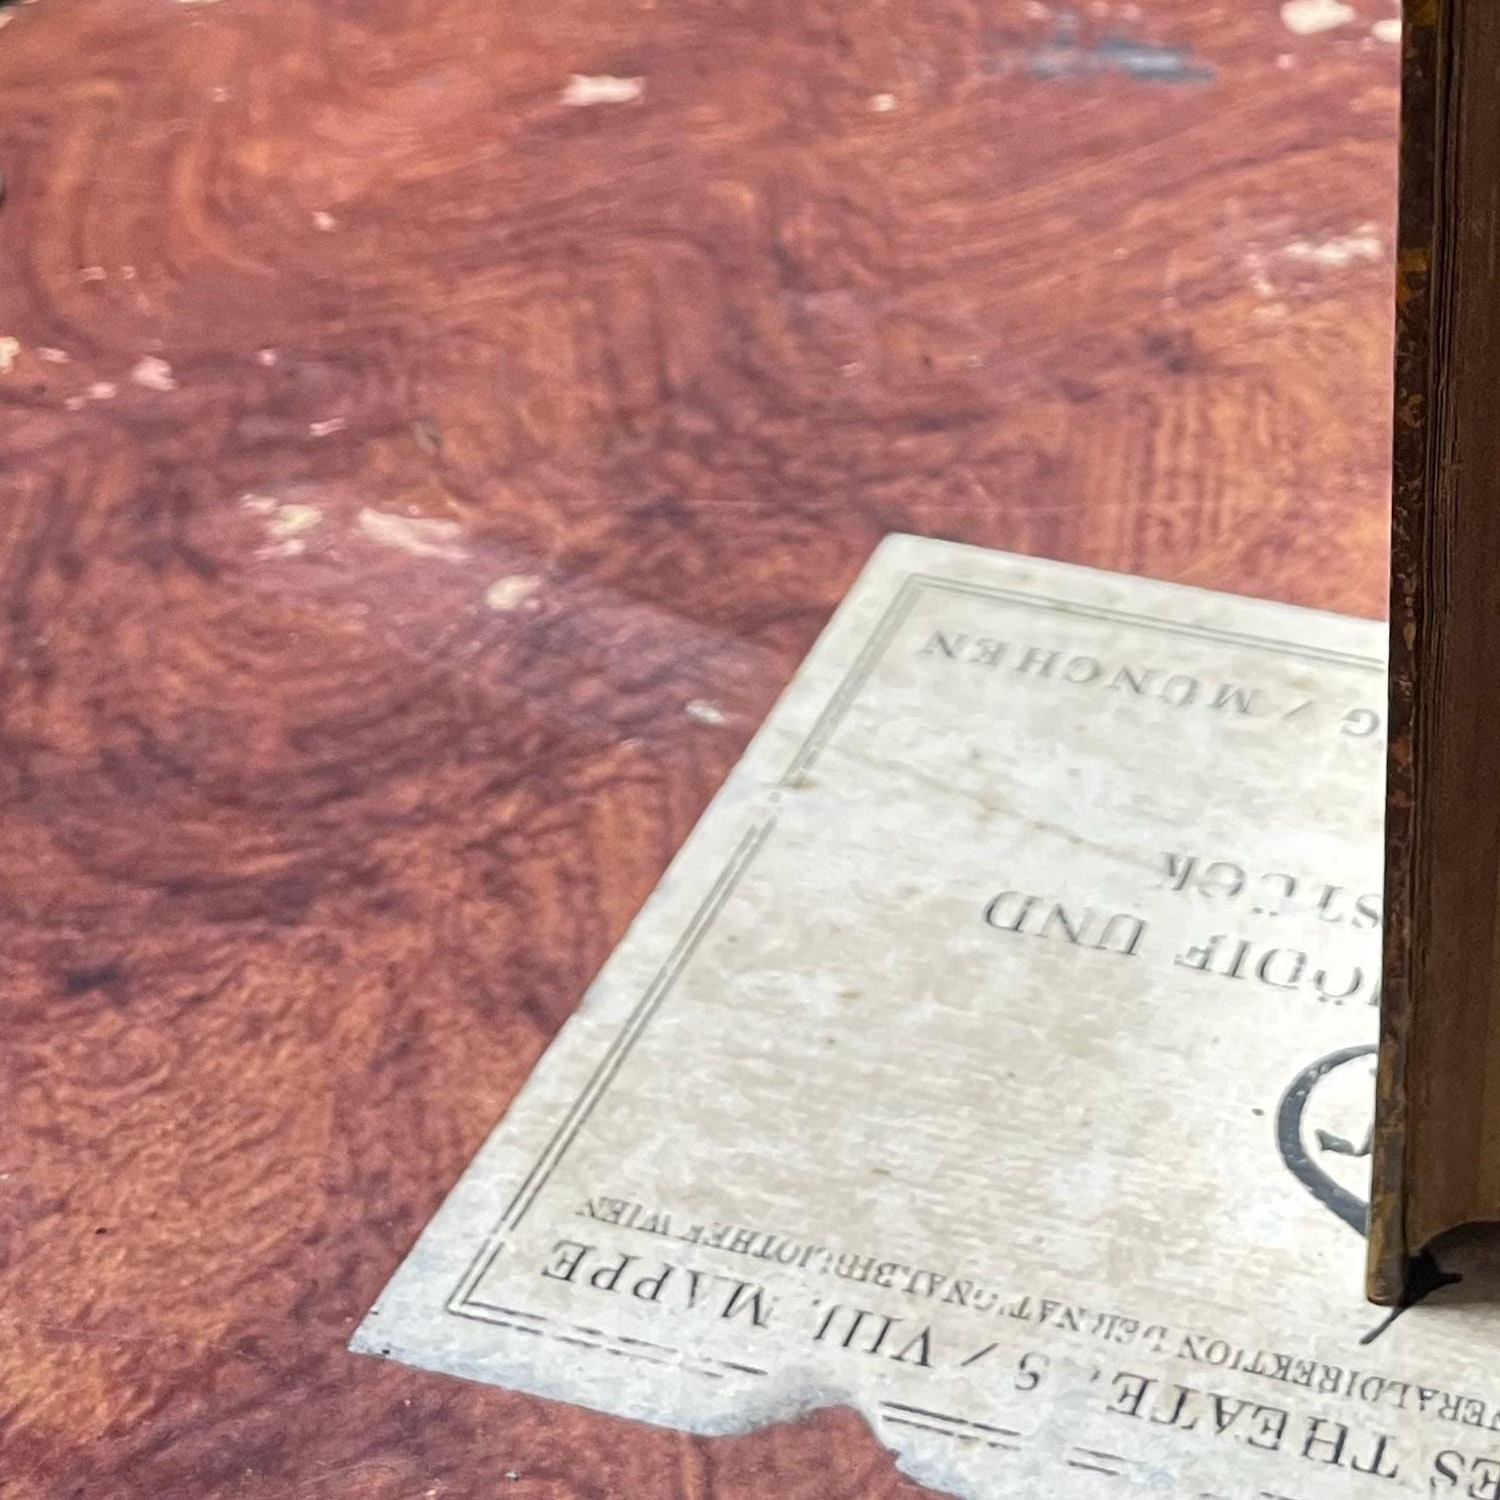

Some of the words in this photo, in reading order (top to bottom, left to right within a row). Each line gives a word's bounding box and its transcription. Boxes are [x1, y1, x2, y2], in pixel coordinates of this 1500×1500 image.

[916, 629, 1262, 716] MÜNCHEN
[984, 890, 1149, 957] UND
[574, 1196, 672, 1238] WIEN
[540, 1238, 777, 1330] MAPPE
[672, 1220, 1087, 1333] NATONALBIBLIOTHEK
[1013, 1350, 1399, 1480] THEATES
